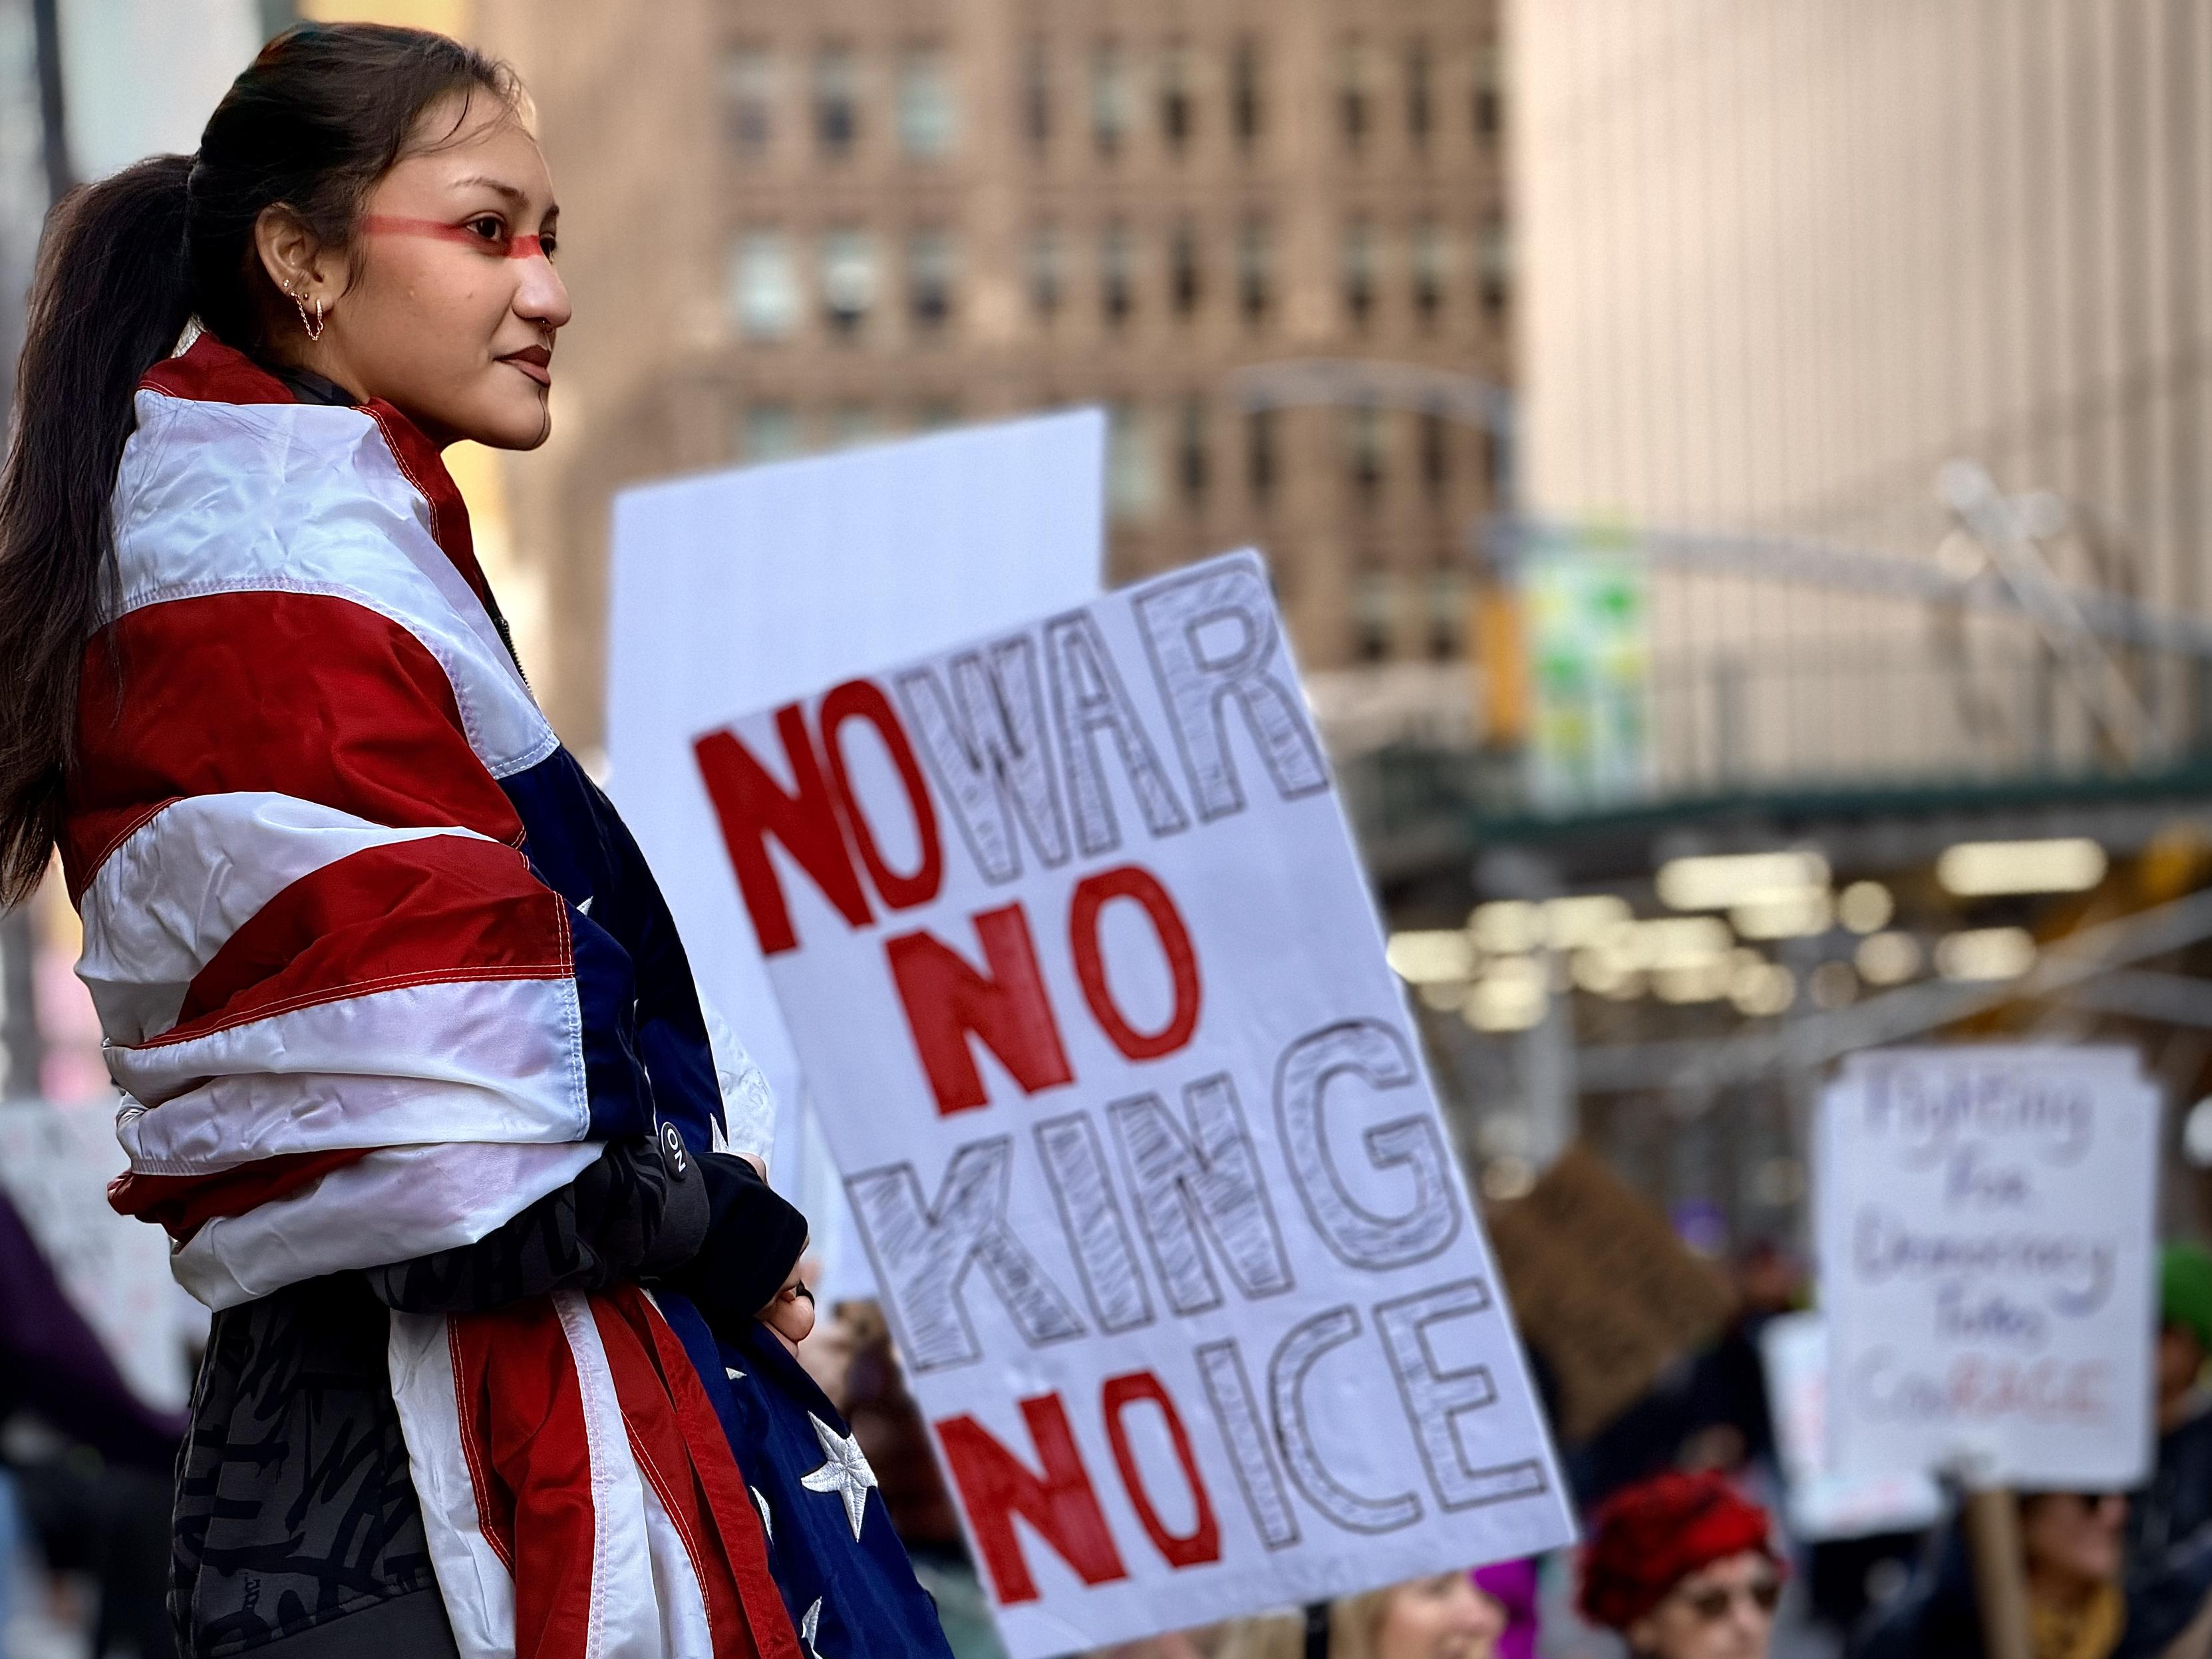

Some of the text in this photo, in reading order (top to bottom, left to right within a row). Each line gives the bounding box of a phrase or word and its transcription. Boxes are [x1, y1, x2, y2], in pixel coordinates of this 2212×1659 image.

[691, 555, 1331, 957] NO WAR
[882, 862, 1203, 1120] NO
[843, 1016, 1461, 1375] KING
[933, 1368, 1222, 1606] NO
[1195, 1277, 1548, 1551] ICE
